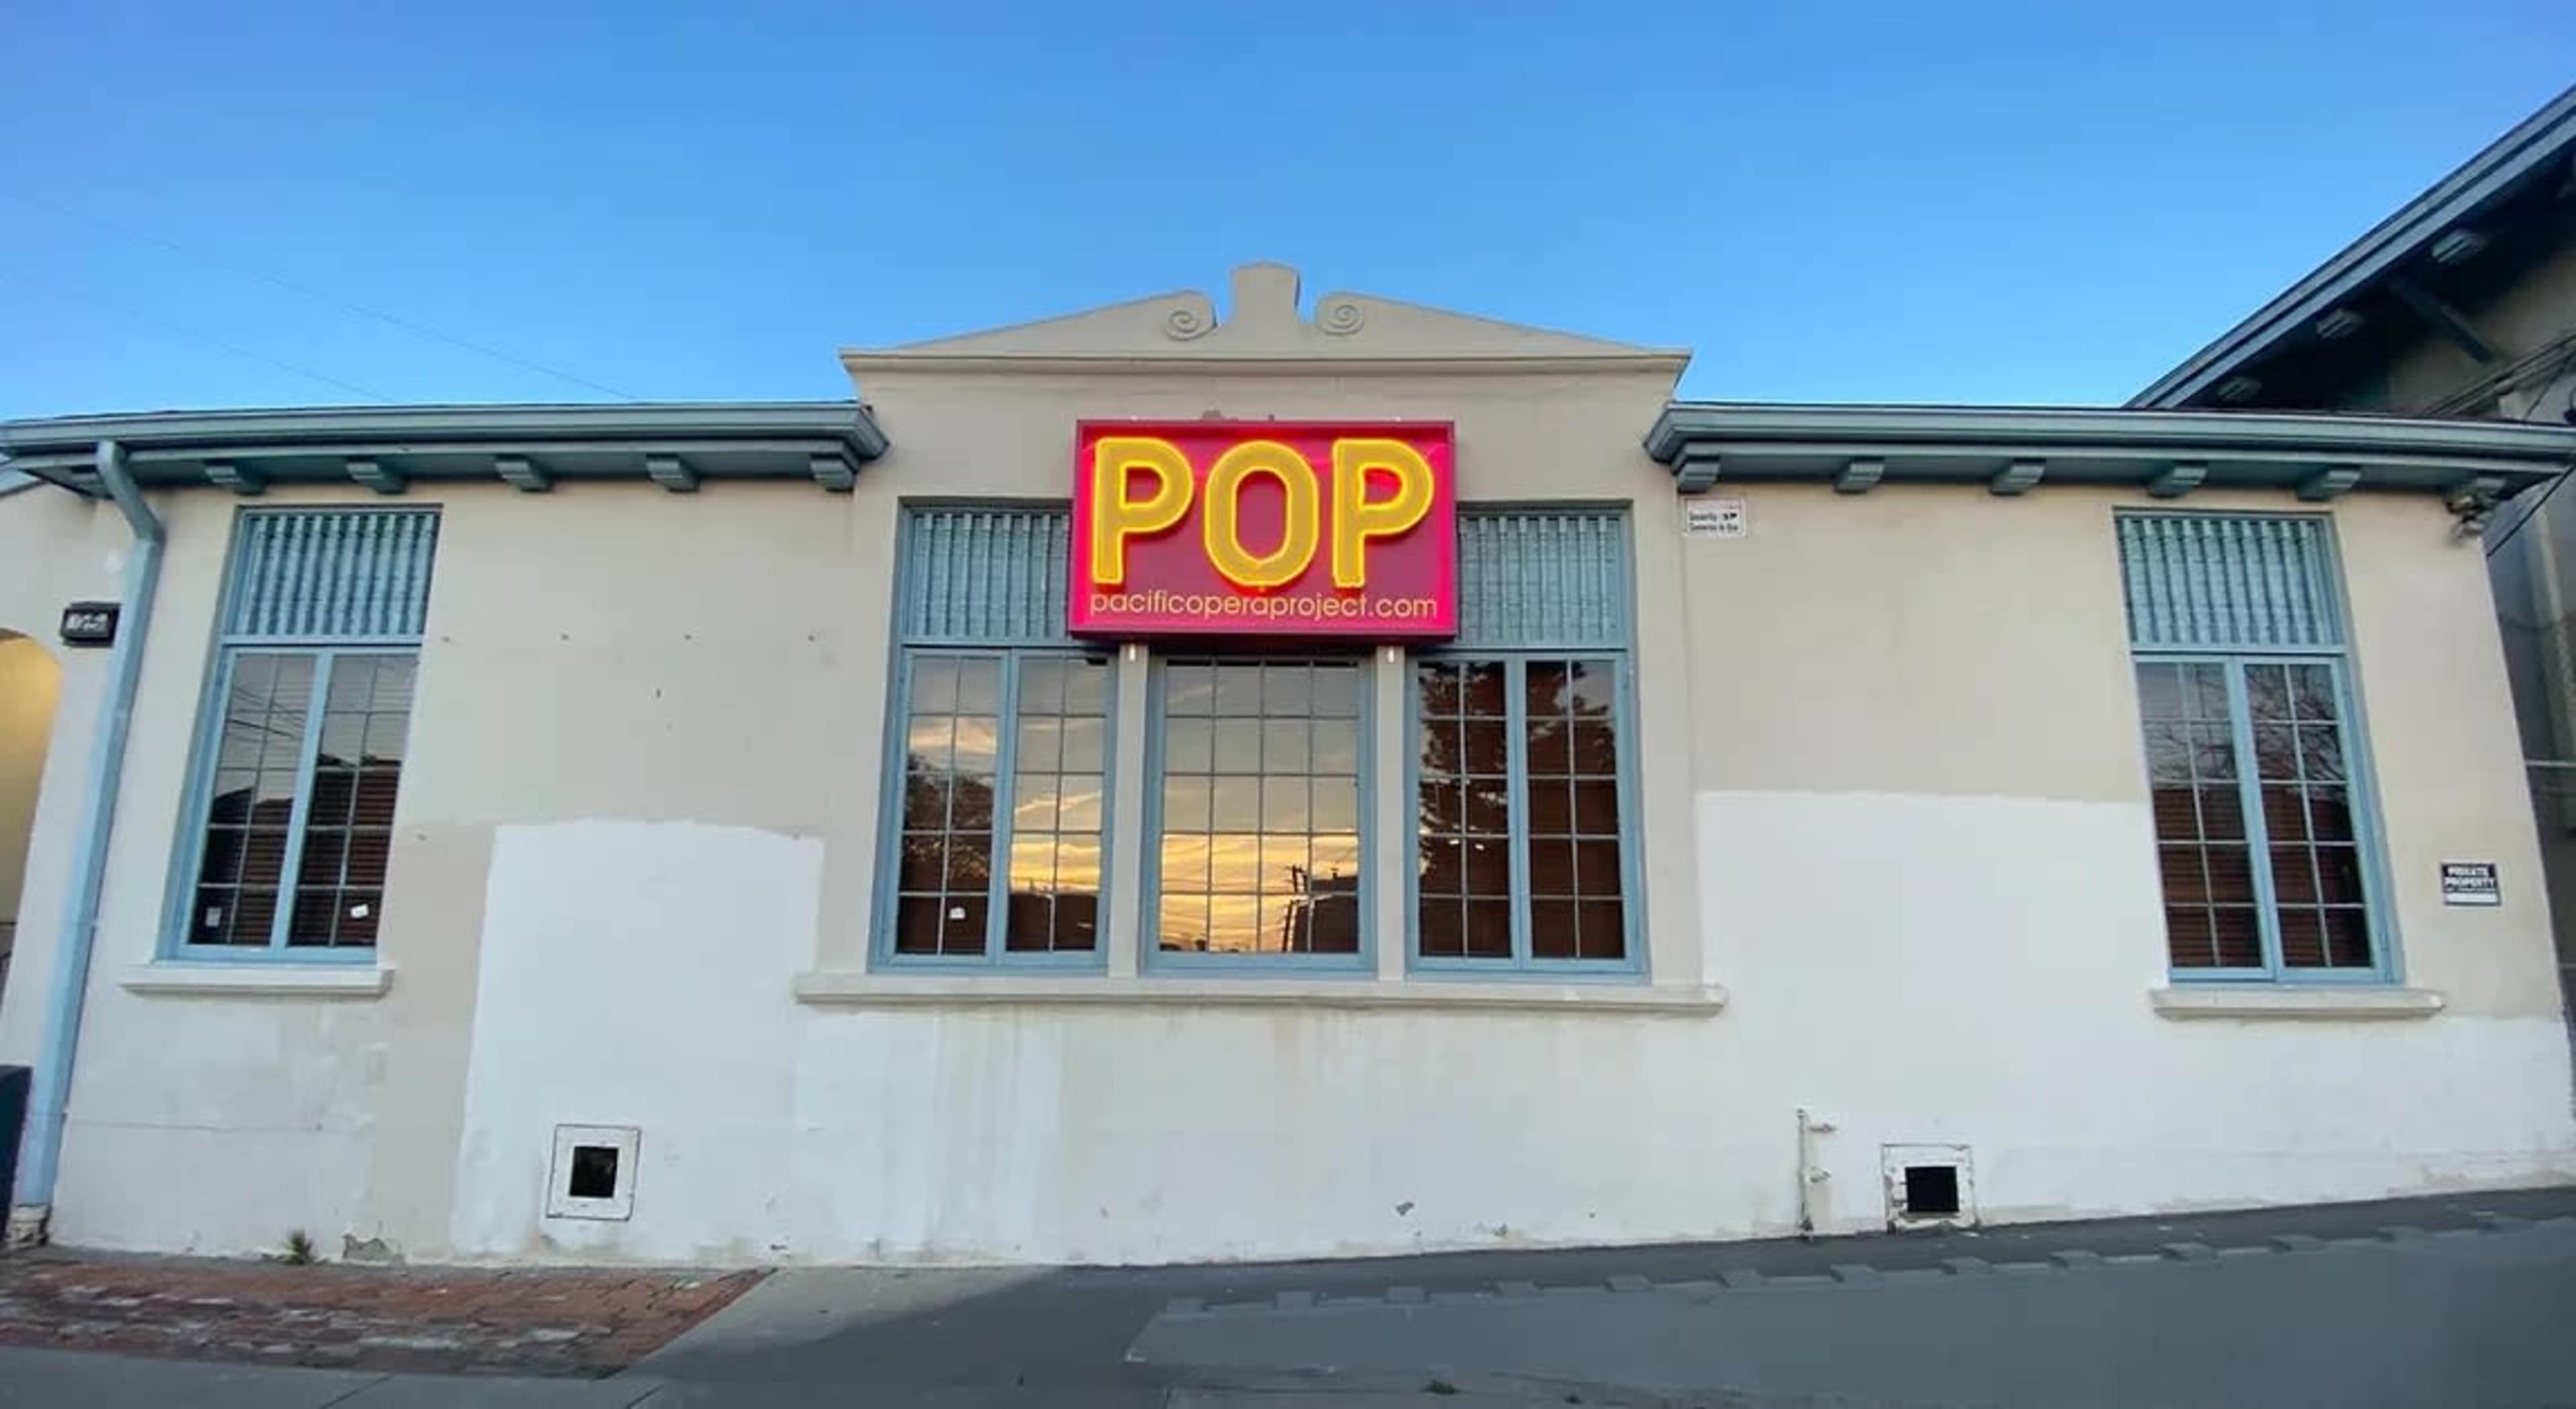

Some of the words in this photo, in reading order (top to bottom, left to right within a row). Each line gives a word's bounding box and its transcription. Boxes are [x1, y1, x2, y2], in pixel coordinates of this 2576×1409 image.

[1092, 437, 1434, 589] POP
[1090, 589, 1438, 621] pacificoperaproject.com
[2445, 877, 2495, 887] PROPERTY
